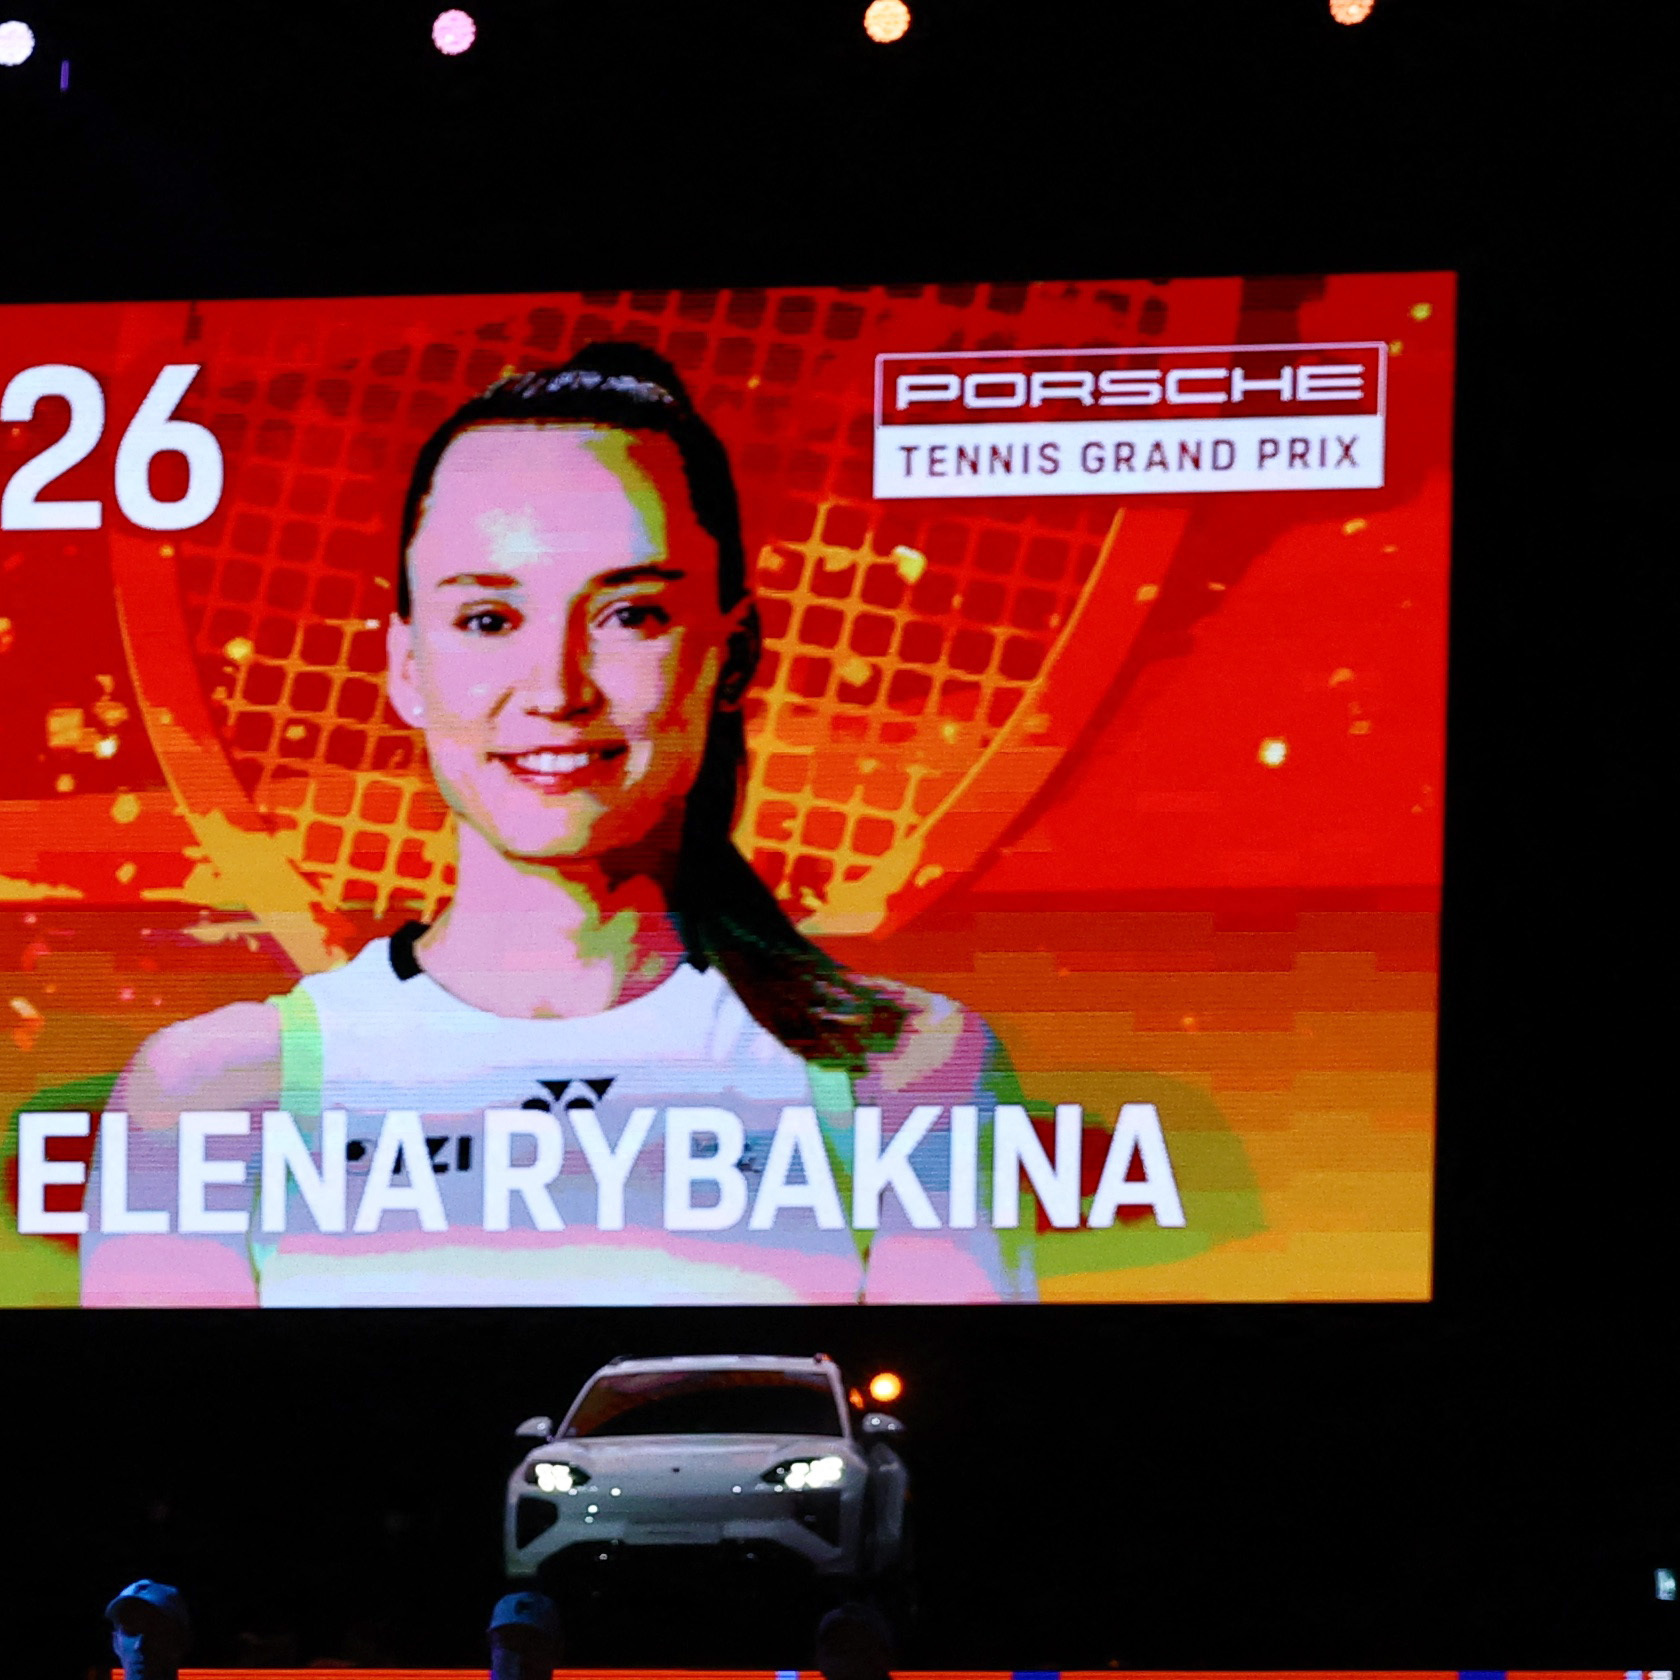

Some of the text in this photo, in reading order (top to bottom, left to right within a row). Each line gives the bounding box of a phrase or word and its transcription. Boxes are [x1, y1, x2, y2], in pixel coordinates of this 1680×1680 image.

[896, 364, 1365, 411] PORSCHE
[900, 435, 1360, 478] TENNIS GRAND PRIX
[16, 1104, 1186, 1234] ELENA RYBAKINA
